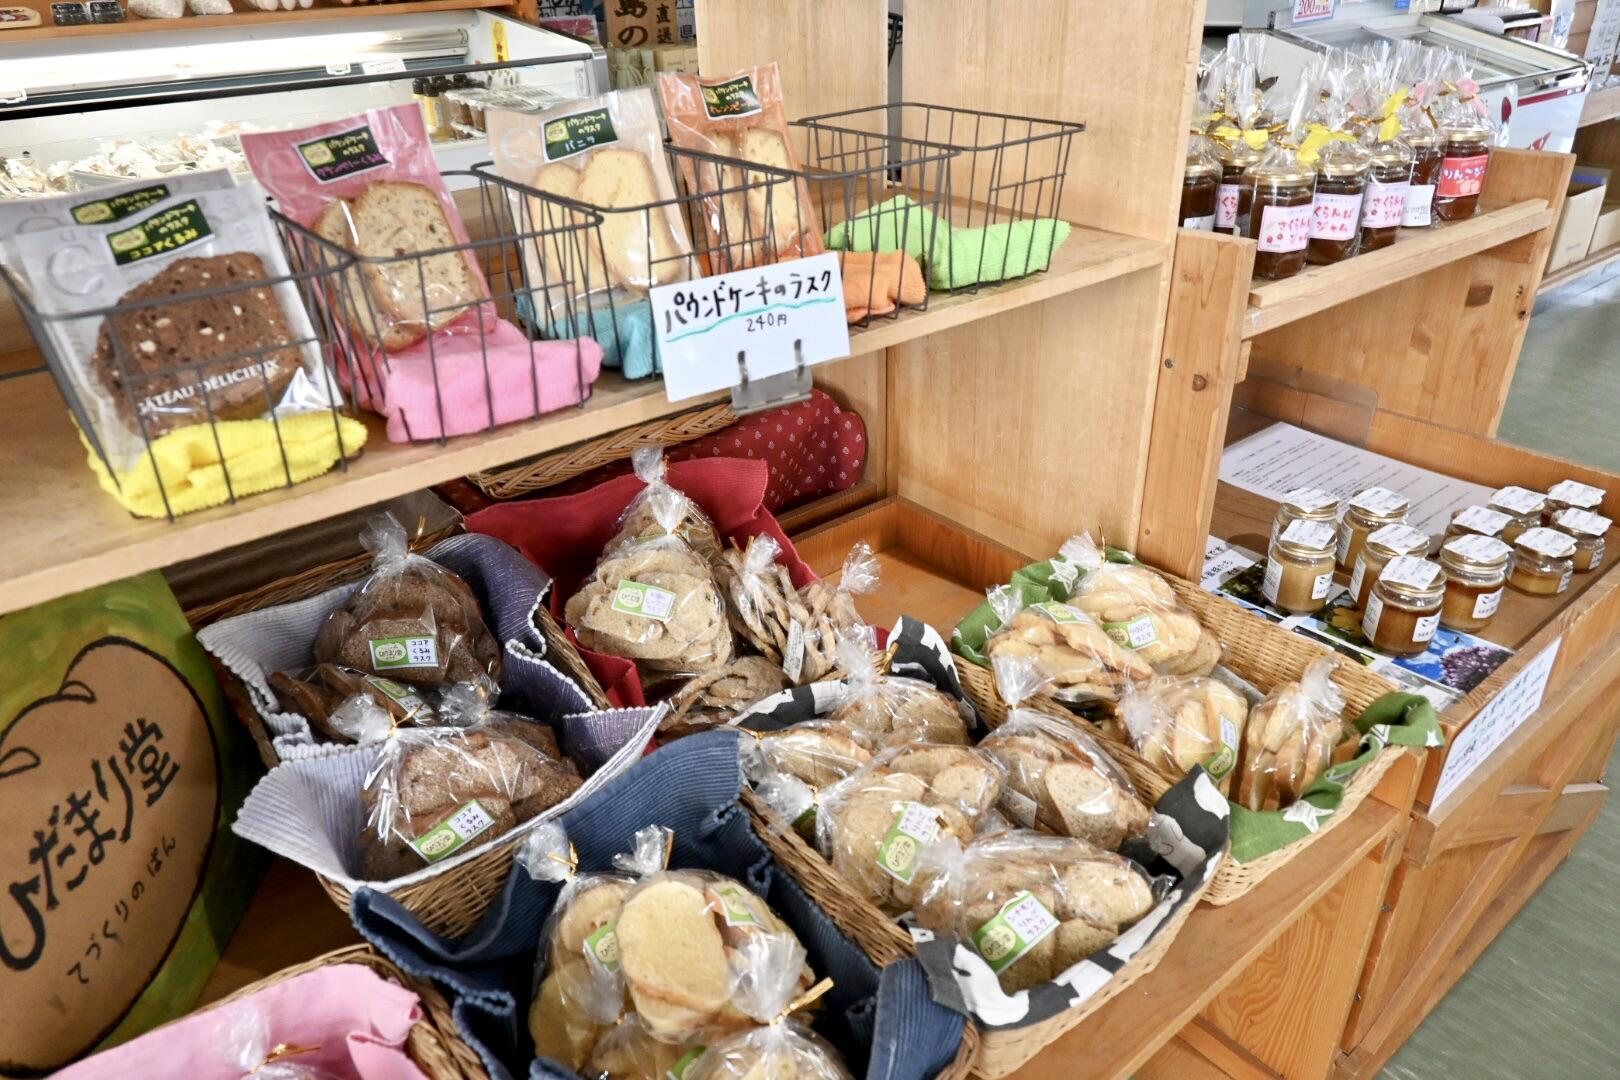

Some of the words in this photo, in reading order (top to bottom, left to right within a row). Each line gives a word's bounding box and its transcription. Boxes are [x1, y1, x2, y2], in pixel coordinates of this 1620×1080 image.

[567, 113, 607, 127] パウンドケーキ
[578, 123, 601, 134] のラスク
[565, 135, 595, 151] バニラ
[145, 203, 196, 231] パウンドケーキ
[129, 227, 199, 260] ココアくるみ
[664, 270, 832, 334] パウンドケーキのラスク
[746, 312, 787, 332] 240円
[455, 807, 472, 823] ココア
[460, 814, 480, 829] くるみ
[0, 717, 180, 971] ひだまり堂
[1027, 918, 1047, 936] ラスク
